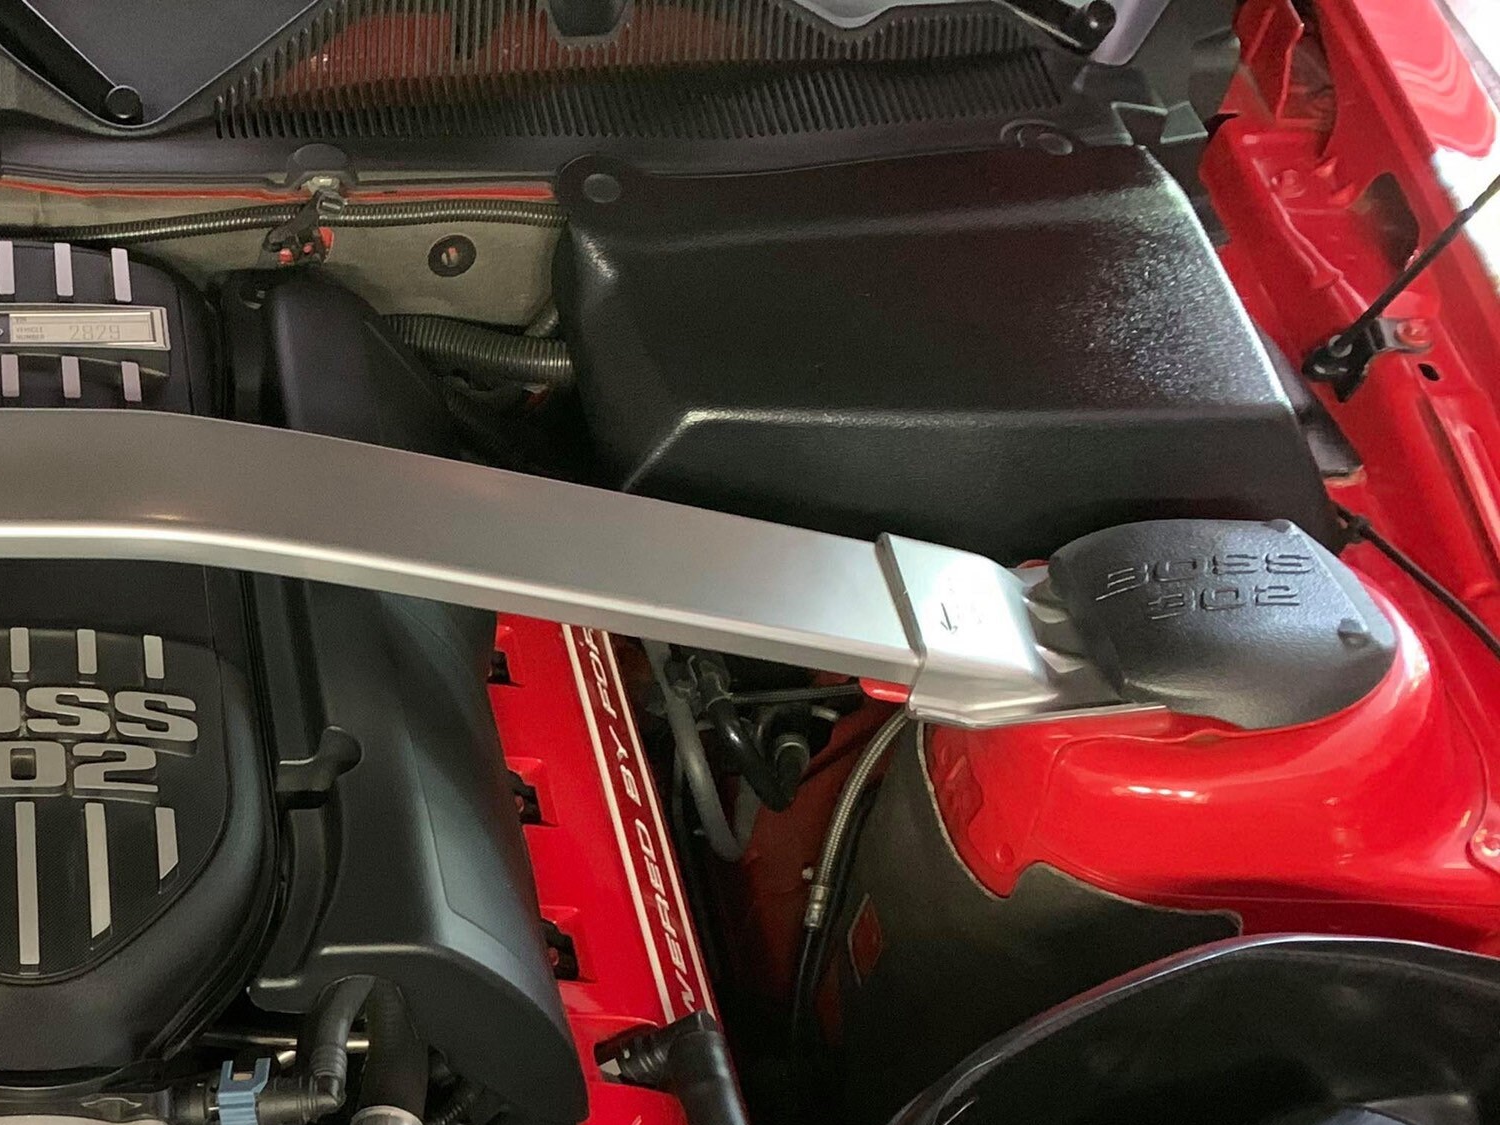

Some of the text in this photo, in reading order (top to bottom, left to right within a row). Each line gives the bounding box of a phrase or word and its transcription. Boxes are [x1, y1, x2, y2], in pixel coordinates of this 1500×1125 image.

[69, 325, 121, 341] 2829
[1096, 553, 1313, 601] BOSS
[1148, 584, 1299, 620] 302
[581, 627, 696, 1013] WERED BY FOR
